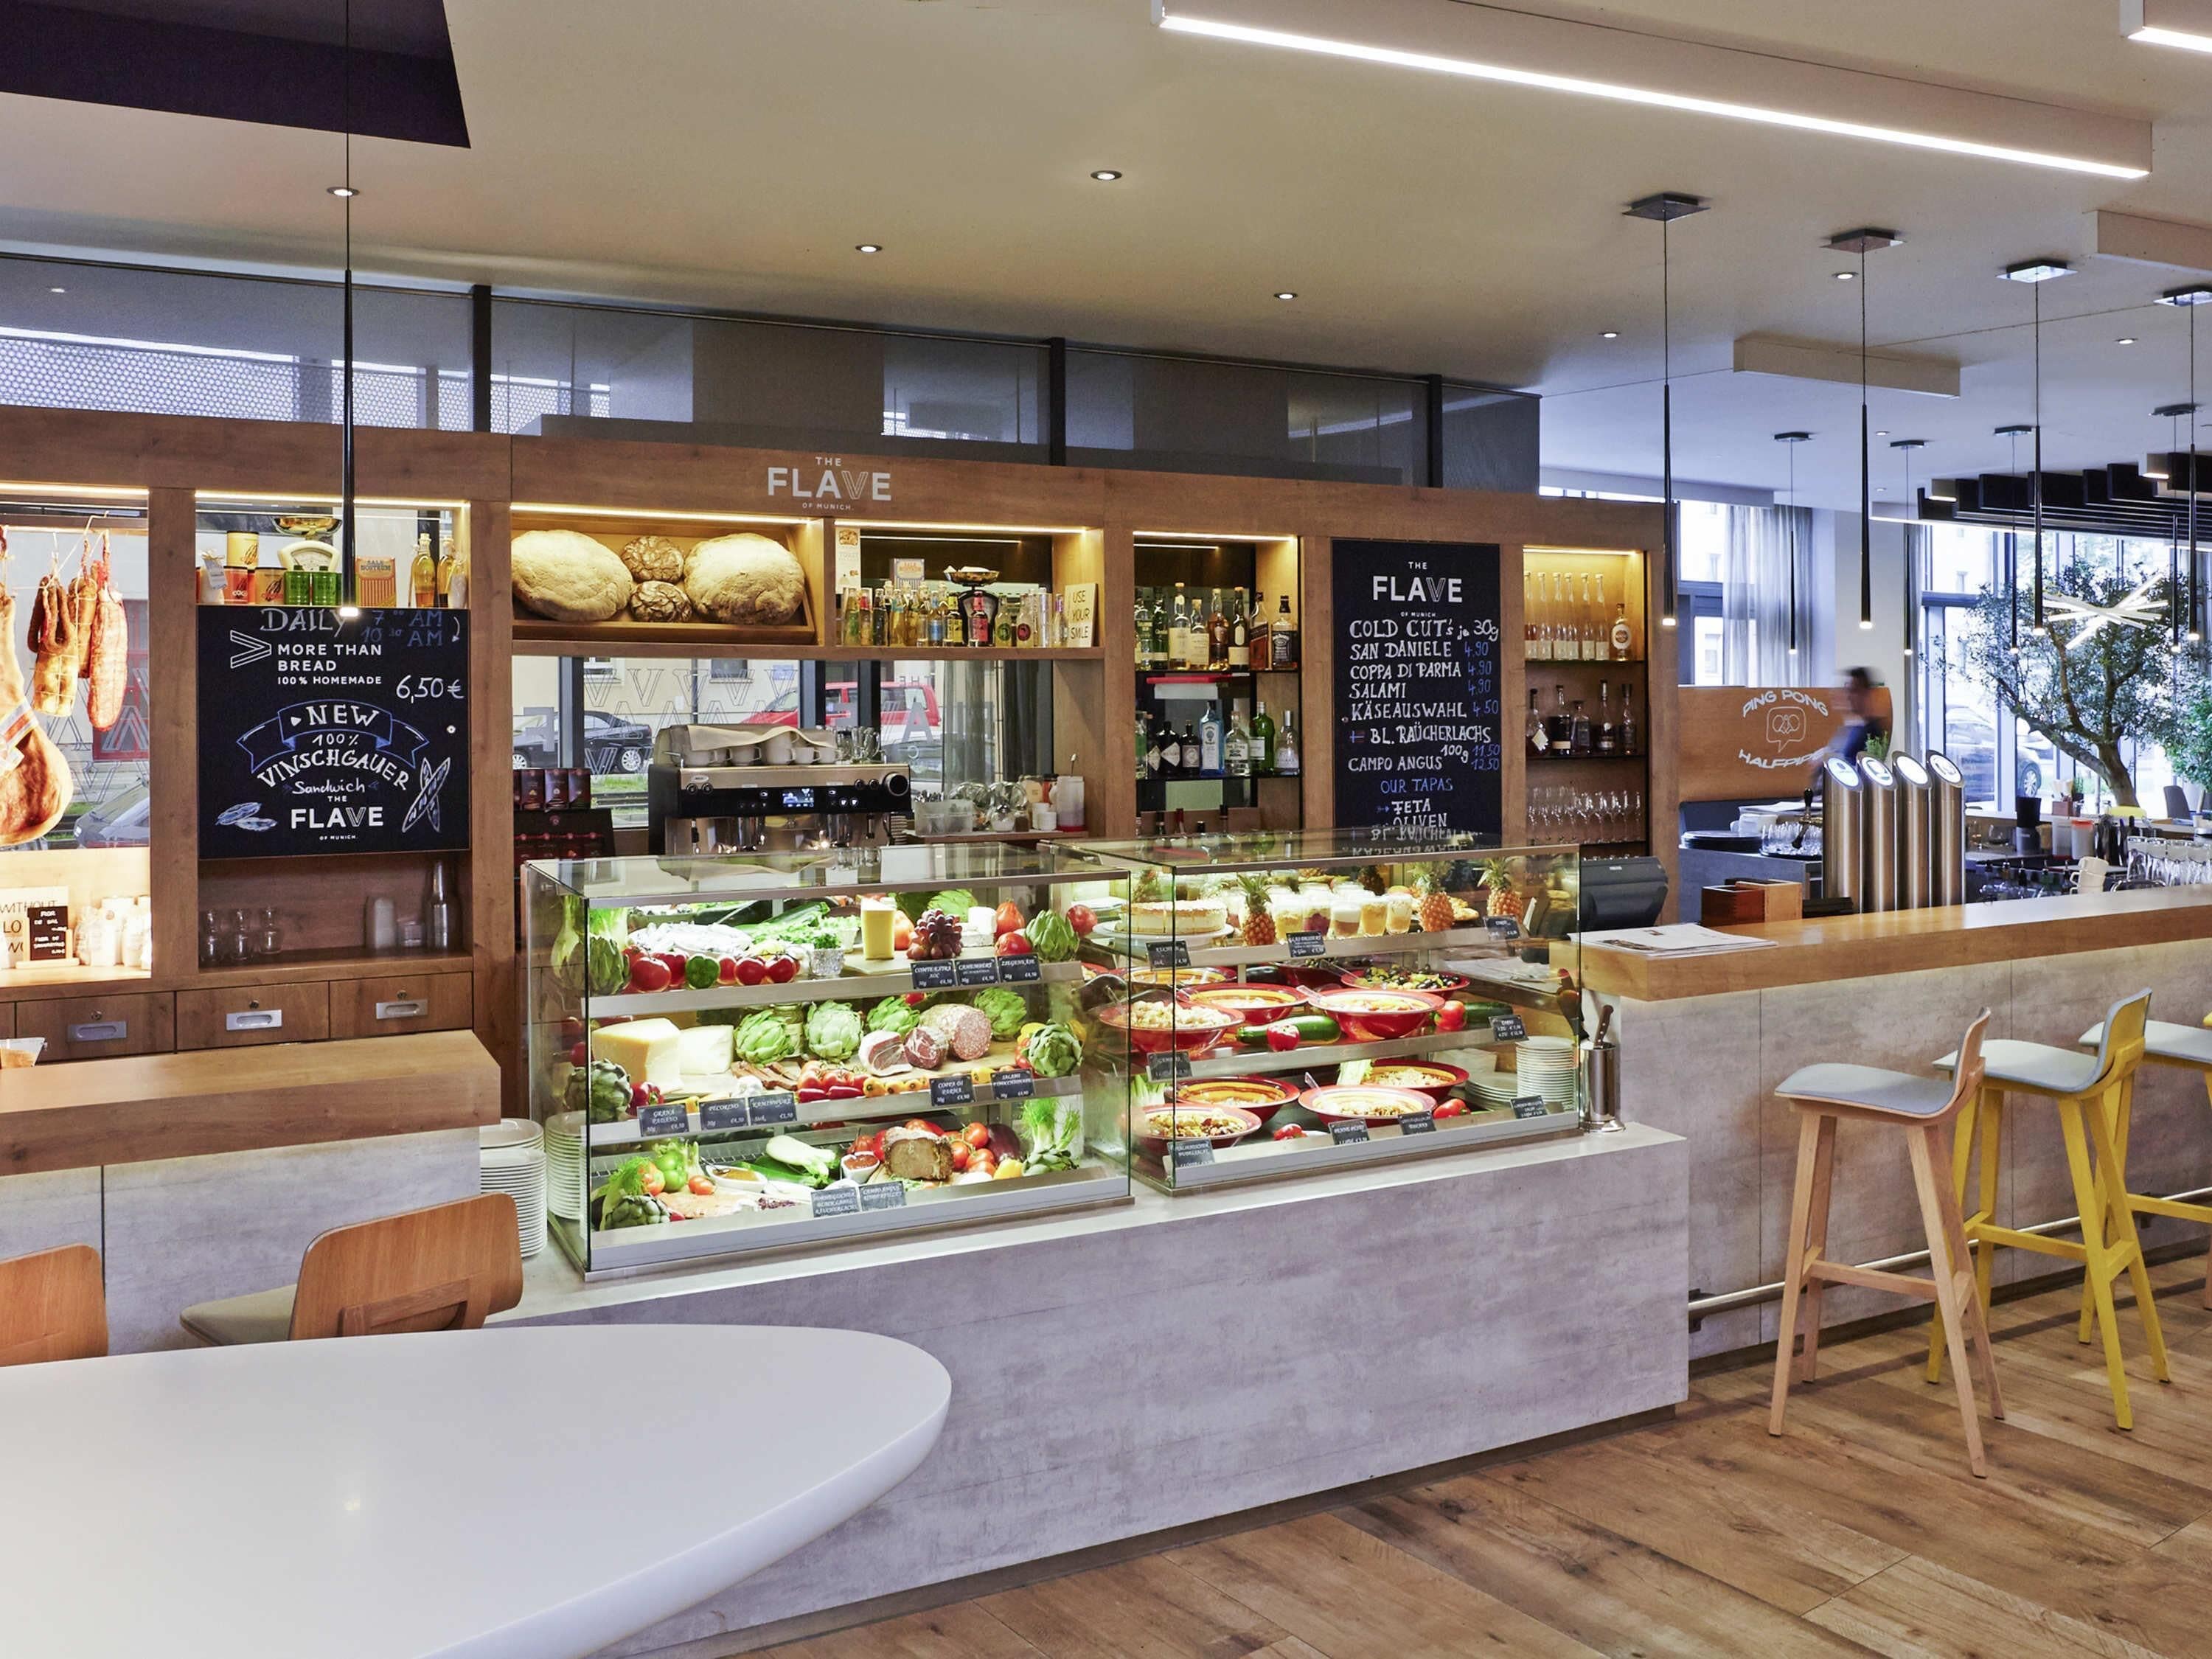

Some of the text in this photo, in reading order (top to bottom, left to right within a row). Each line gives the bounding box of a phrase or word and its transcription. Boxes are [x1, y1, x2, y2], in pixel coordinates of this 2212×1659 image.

[815, 456, 842, 467] THE
[768, 467, 891, 501] FLAVE
[1408, 561, 1428, 570] THE
[1072, 590, 1086, 603] USE
[1372, 575, 1463, 603] FLAVE
[260, 608, 347, 637] DAILY
[372, 609, 385, 626] 7
[408, 610, 442, 627] AM
[1071, 608, 1090, 621] YOUR
[361, 626, 383, 644] 10
[406, 630, 443, 647] AM
[1070, 627, 1088, 640] SMILE
[1349, 619, 1398, 639] COLD
[1472, 619, 1499, 641] 30g
[277, 644, 382, 656] MORE THAN
[1349, 644, 1379, 661] SAN
[1385, 641, 1452, 658] DANIELE
[277, 660, 337, 672] BREAD
[1349, 665, 1392, 681] COPPA
[1397, 664, 1413, 678] DI
[1416, 662, 1461, 678] PARMA
[313, 676, 382, 686] HOMEMADE
[1349, 682, 1407, 700] SALAMI
[1351, 702, 1467, 722] KÄSEAUSWAHL
[1742, 689, 1829, 718] PING PONG
[305, 704, 380, 728] NEW
[312, 733, 359, 747] 100%
[1369, 724, 1492, 745] BL. RAÜCHERLACHS
[1440, 744, 1469, 763] 100g
[257, 748, 410, 791] VINSCHGAUER
[1348, 757, 1393, 772] CAMPO
[1397, 755, 1443, 771] ANGUS
[292, 777, 366, 795] Sandwich
[1380, 777, 1453, 794] OUR TAPAS
[1391, 798, 1432, 815] FETA
[291, 806, 384, 830] FLAVE
